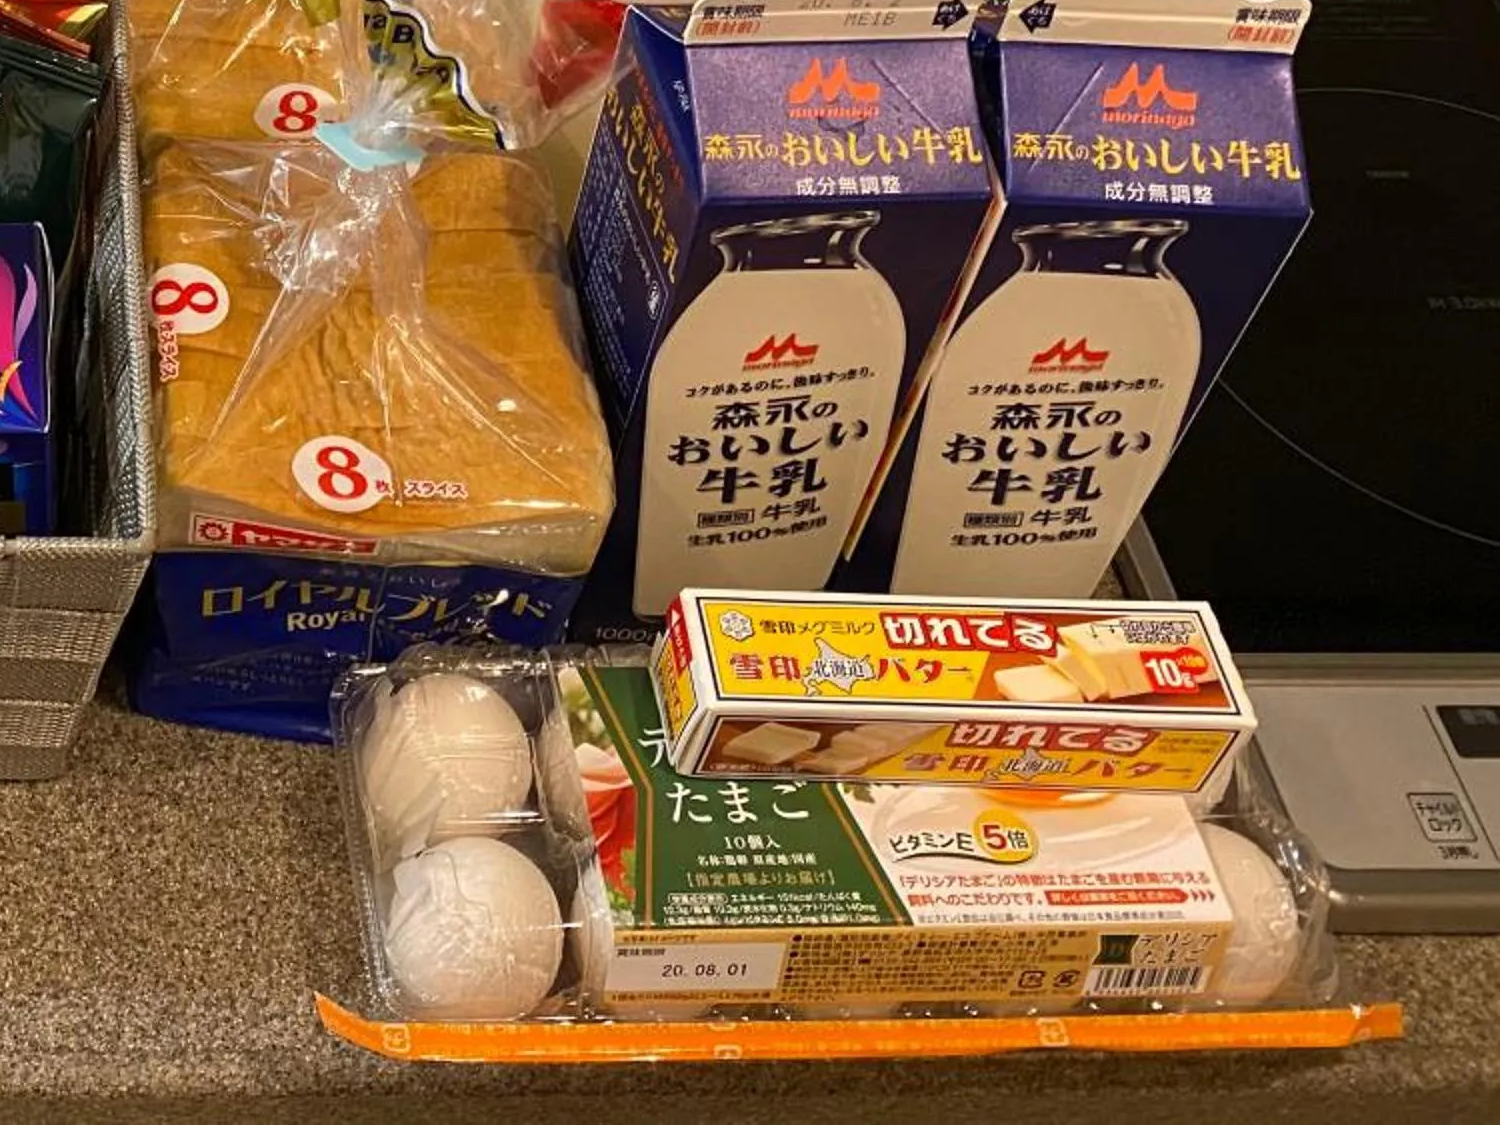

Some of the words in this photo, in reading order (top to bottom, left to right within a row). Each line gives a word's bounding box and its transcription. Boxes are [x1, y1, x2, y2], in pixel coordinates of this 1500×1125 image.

[273, 91, 319, 132] 8
[1103, 111, 1196, 130] morinaga
[705, 125, 984, 166] 森永のおいしい牛乳
[1013, 133, 1301, 180] 森永のおいしい牛乳
[796, 176, 902, 196] 成分無調整
[1104, 183, 1214, 205] 成分無調整
[152, 280, 218, 315] 8
[712, 395, 838, 431] 森永の
[990, 401, 1122, 430] 森永の
[668, 419, 868, 466] おいしい
[942, 431, 1151, 464] おいしい
[316, 446, 368, 499] 8
[697, 458, 827, 504] 牛乳
[967, 466, 1103, 506] 牛乳
[761, 497, 821, 520] 牛乳
[1031, 507, 1092, 525] 牛乳
[202, 579, 551, 621] ロイヤルブレッド
[760, 620, 876, 635] 雪印メグミルク
[884, 615, 1053, 650] 切れてる
[950, 725, 1149, 754] 切れてる
[665, 781, 810, 824] たまご
[723, 834, 781, 850] 10個入
[889, 831, 974, 854] ビタミンE
[982, 823, 1030, 851] 5倍
